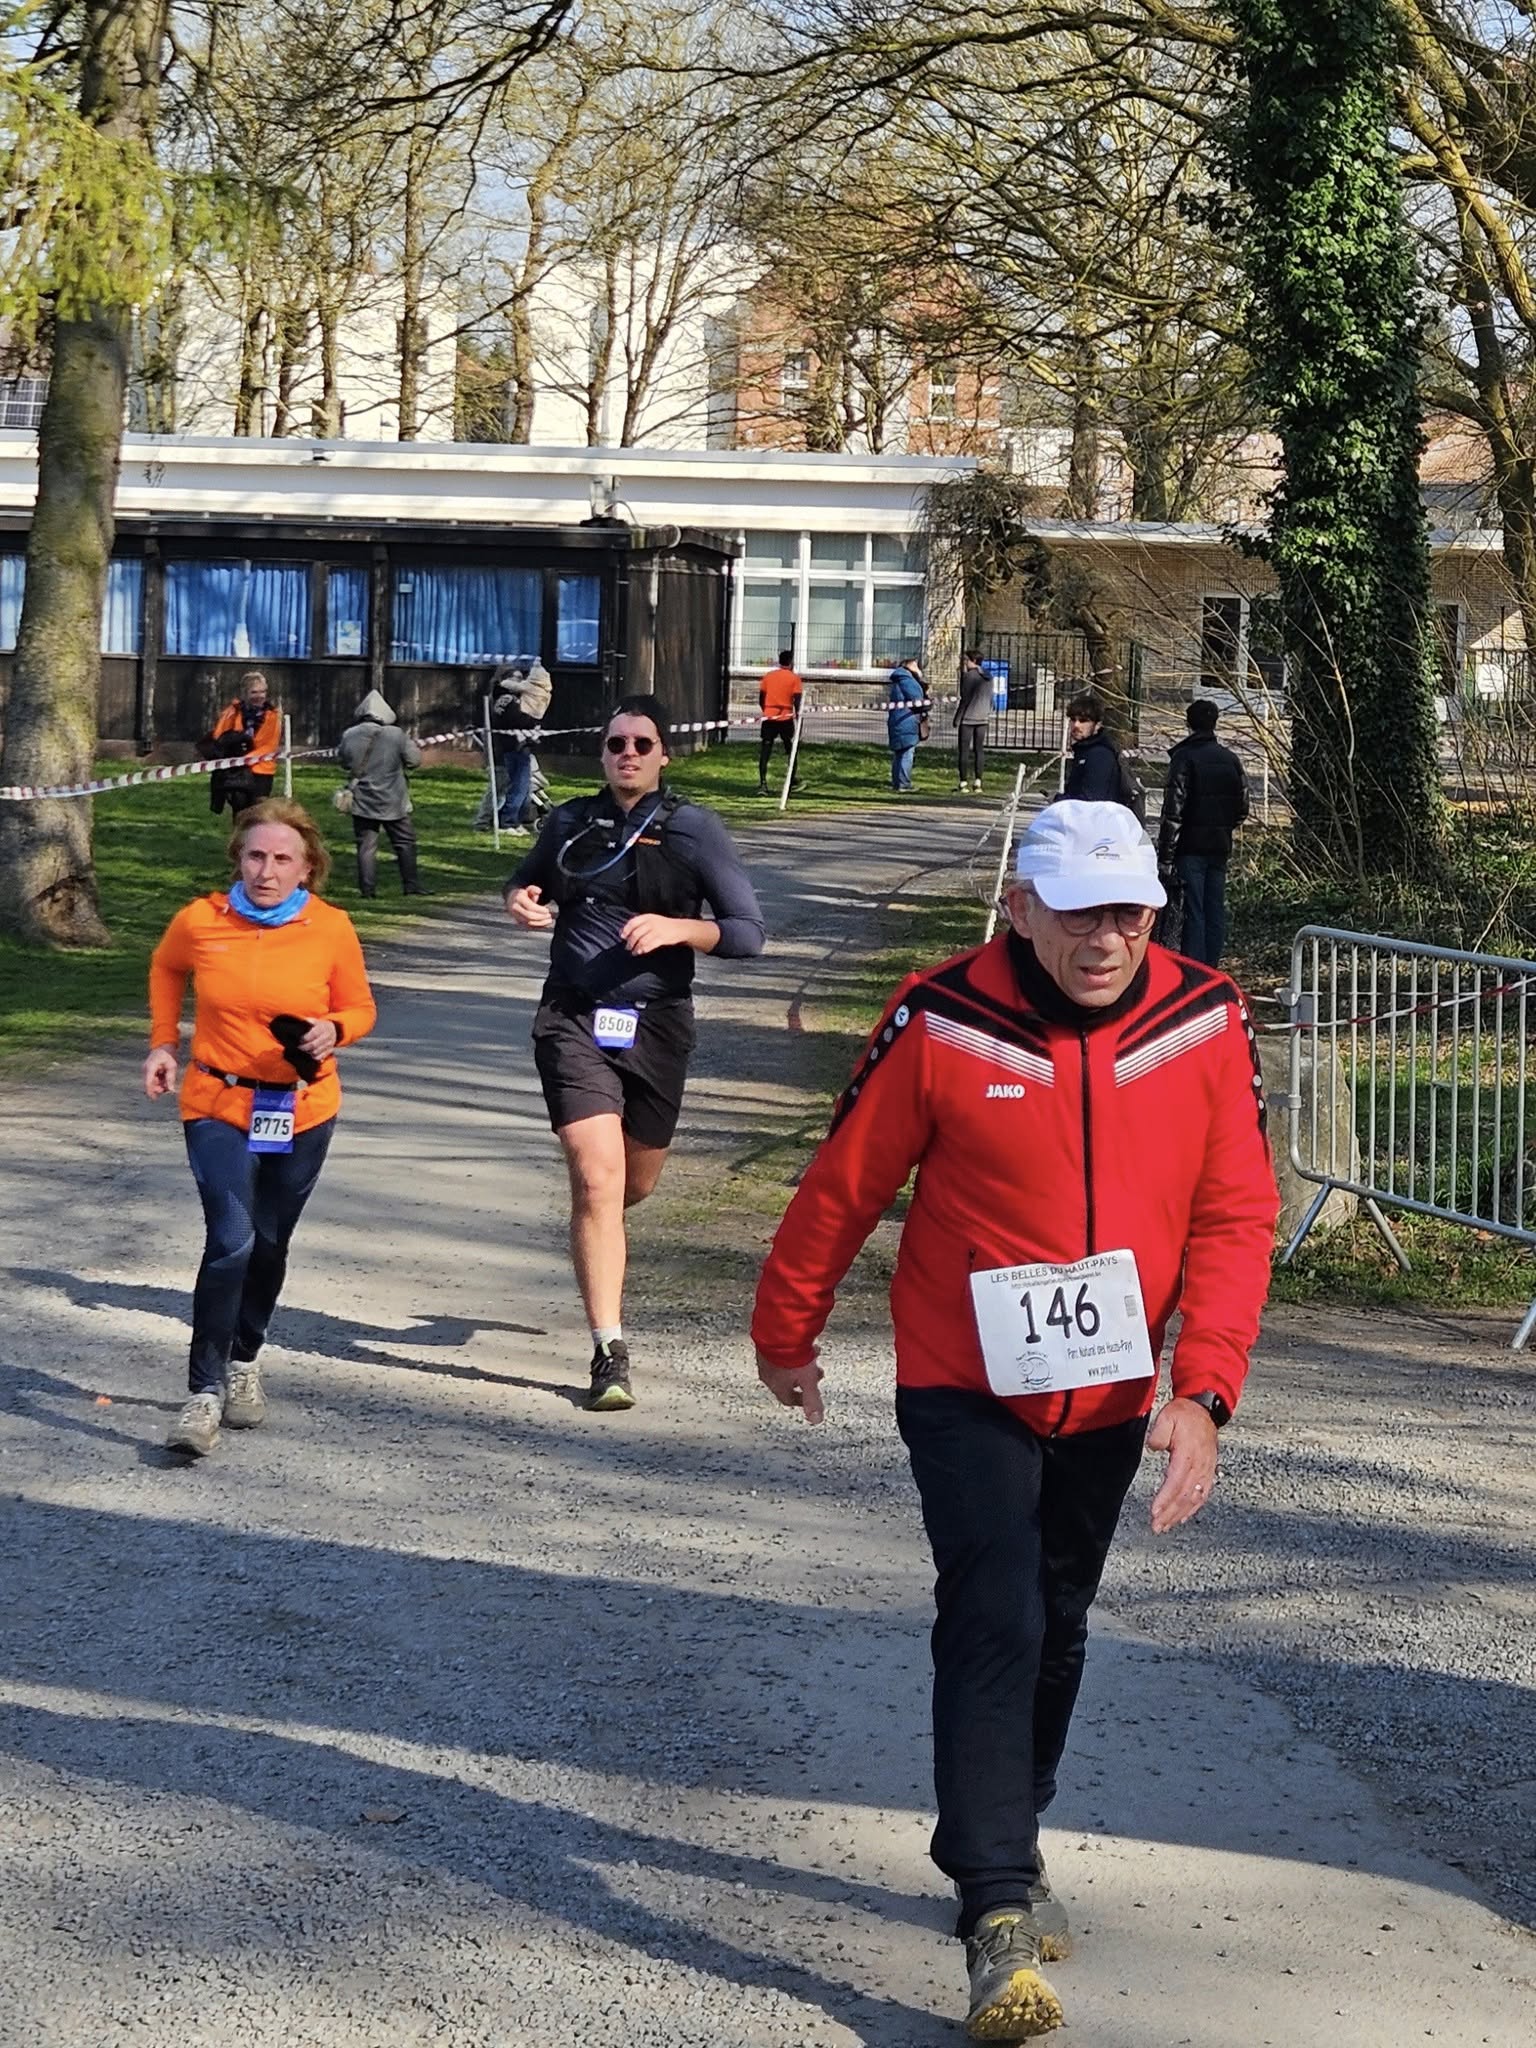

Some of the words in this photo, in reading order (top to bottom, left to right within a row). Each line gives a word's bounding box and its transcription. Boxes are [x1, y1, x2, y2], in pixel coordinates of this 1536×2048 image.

[598, 1015, 634, 1033] 8508
[985, 1083, 1026, 1099] JAKO
[253, 1116, 291, 1135] 8775
[990, 1272, 1009, 1283] LES
[1011, 1266, 1048, 1281] BELLES
[1050, 1266, 1064, 1275] DU
[1065, 1255, 1119, 1274] HAUT-PAYS
[1020, 1282, 1100, 1344] 146
